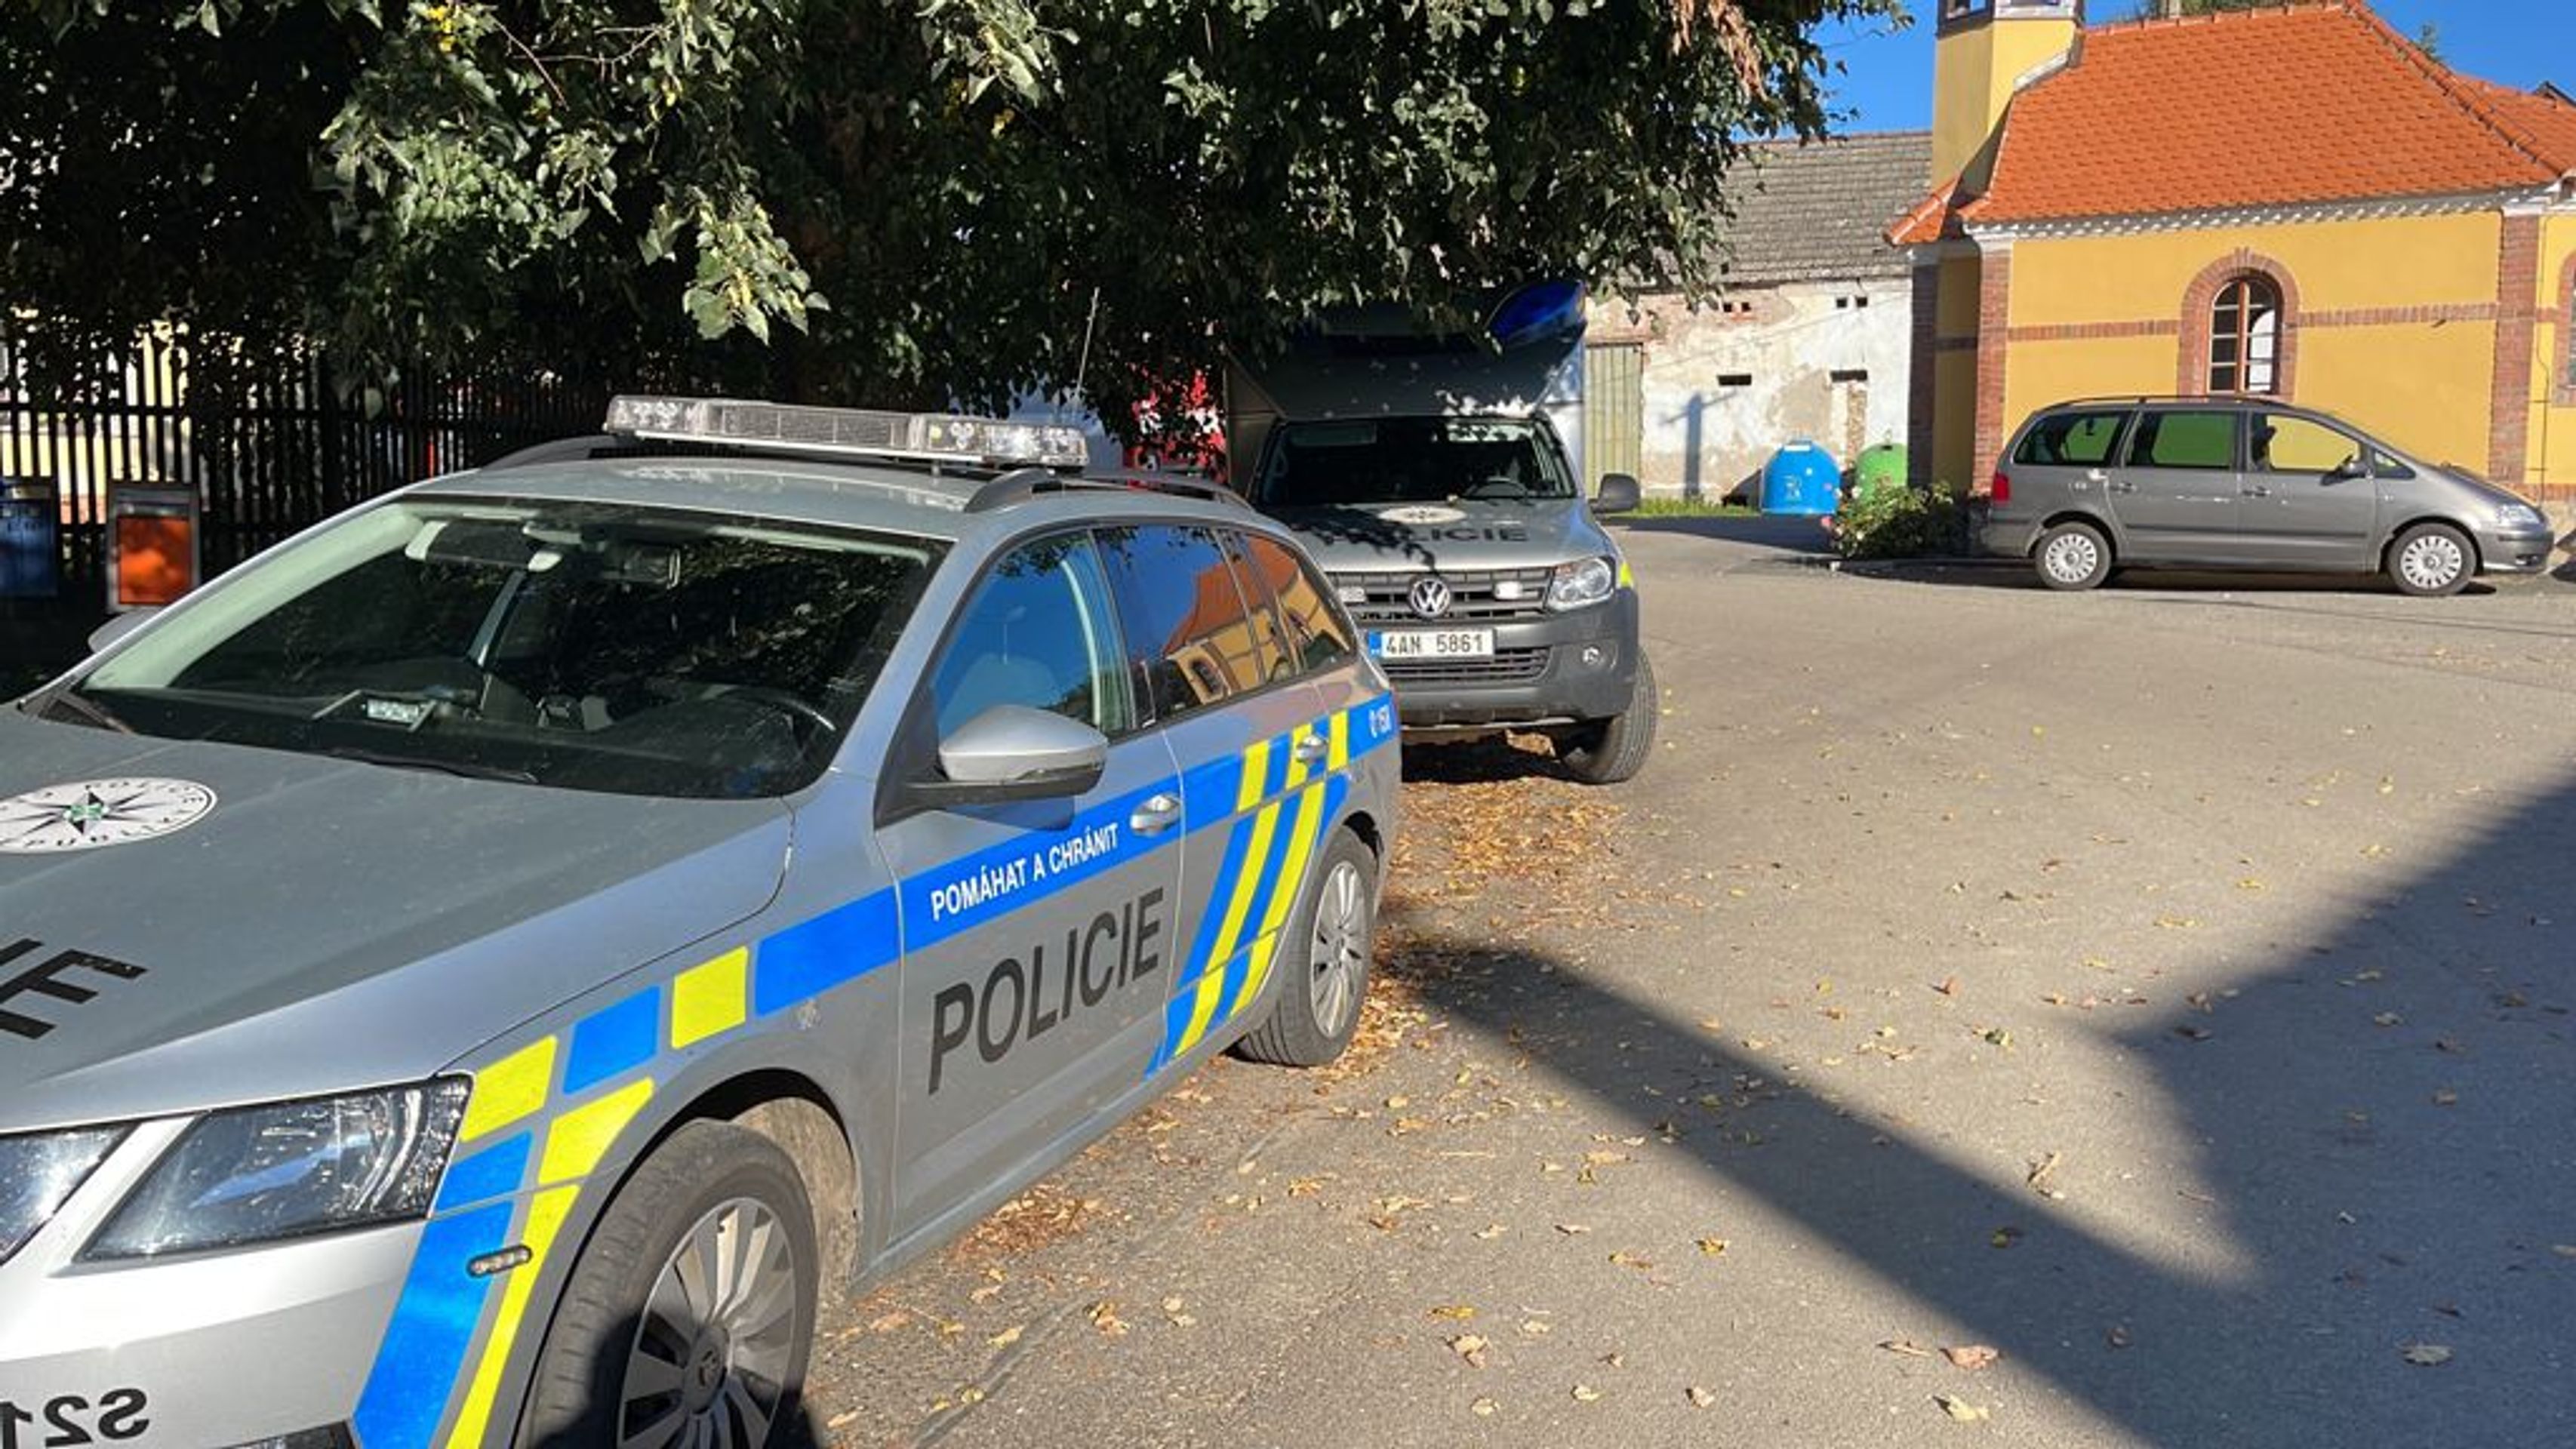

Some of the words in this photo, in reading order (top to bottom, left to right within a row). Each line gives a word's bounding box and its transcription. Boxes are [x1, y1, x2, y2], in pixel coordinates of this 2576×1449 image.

[1386, 636, 1420, 654] 4AN
[1436, 634, 1483, 653] 5861
[931, 857, 1027, 921] POMÁHAT
[1033, 853, 1046, 881] A
[1048, 823, 1119, 874] CHRÁNIT
[928, 886, 1164, 1096] POLICIE
